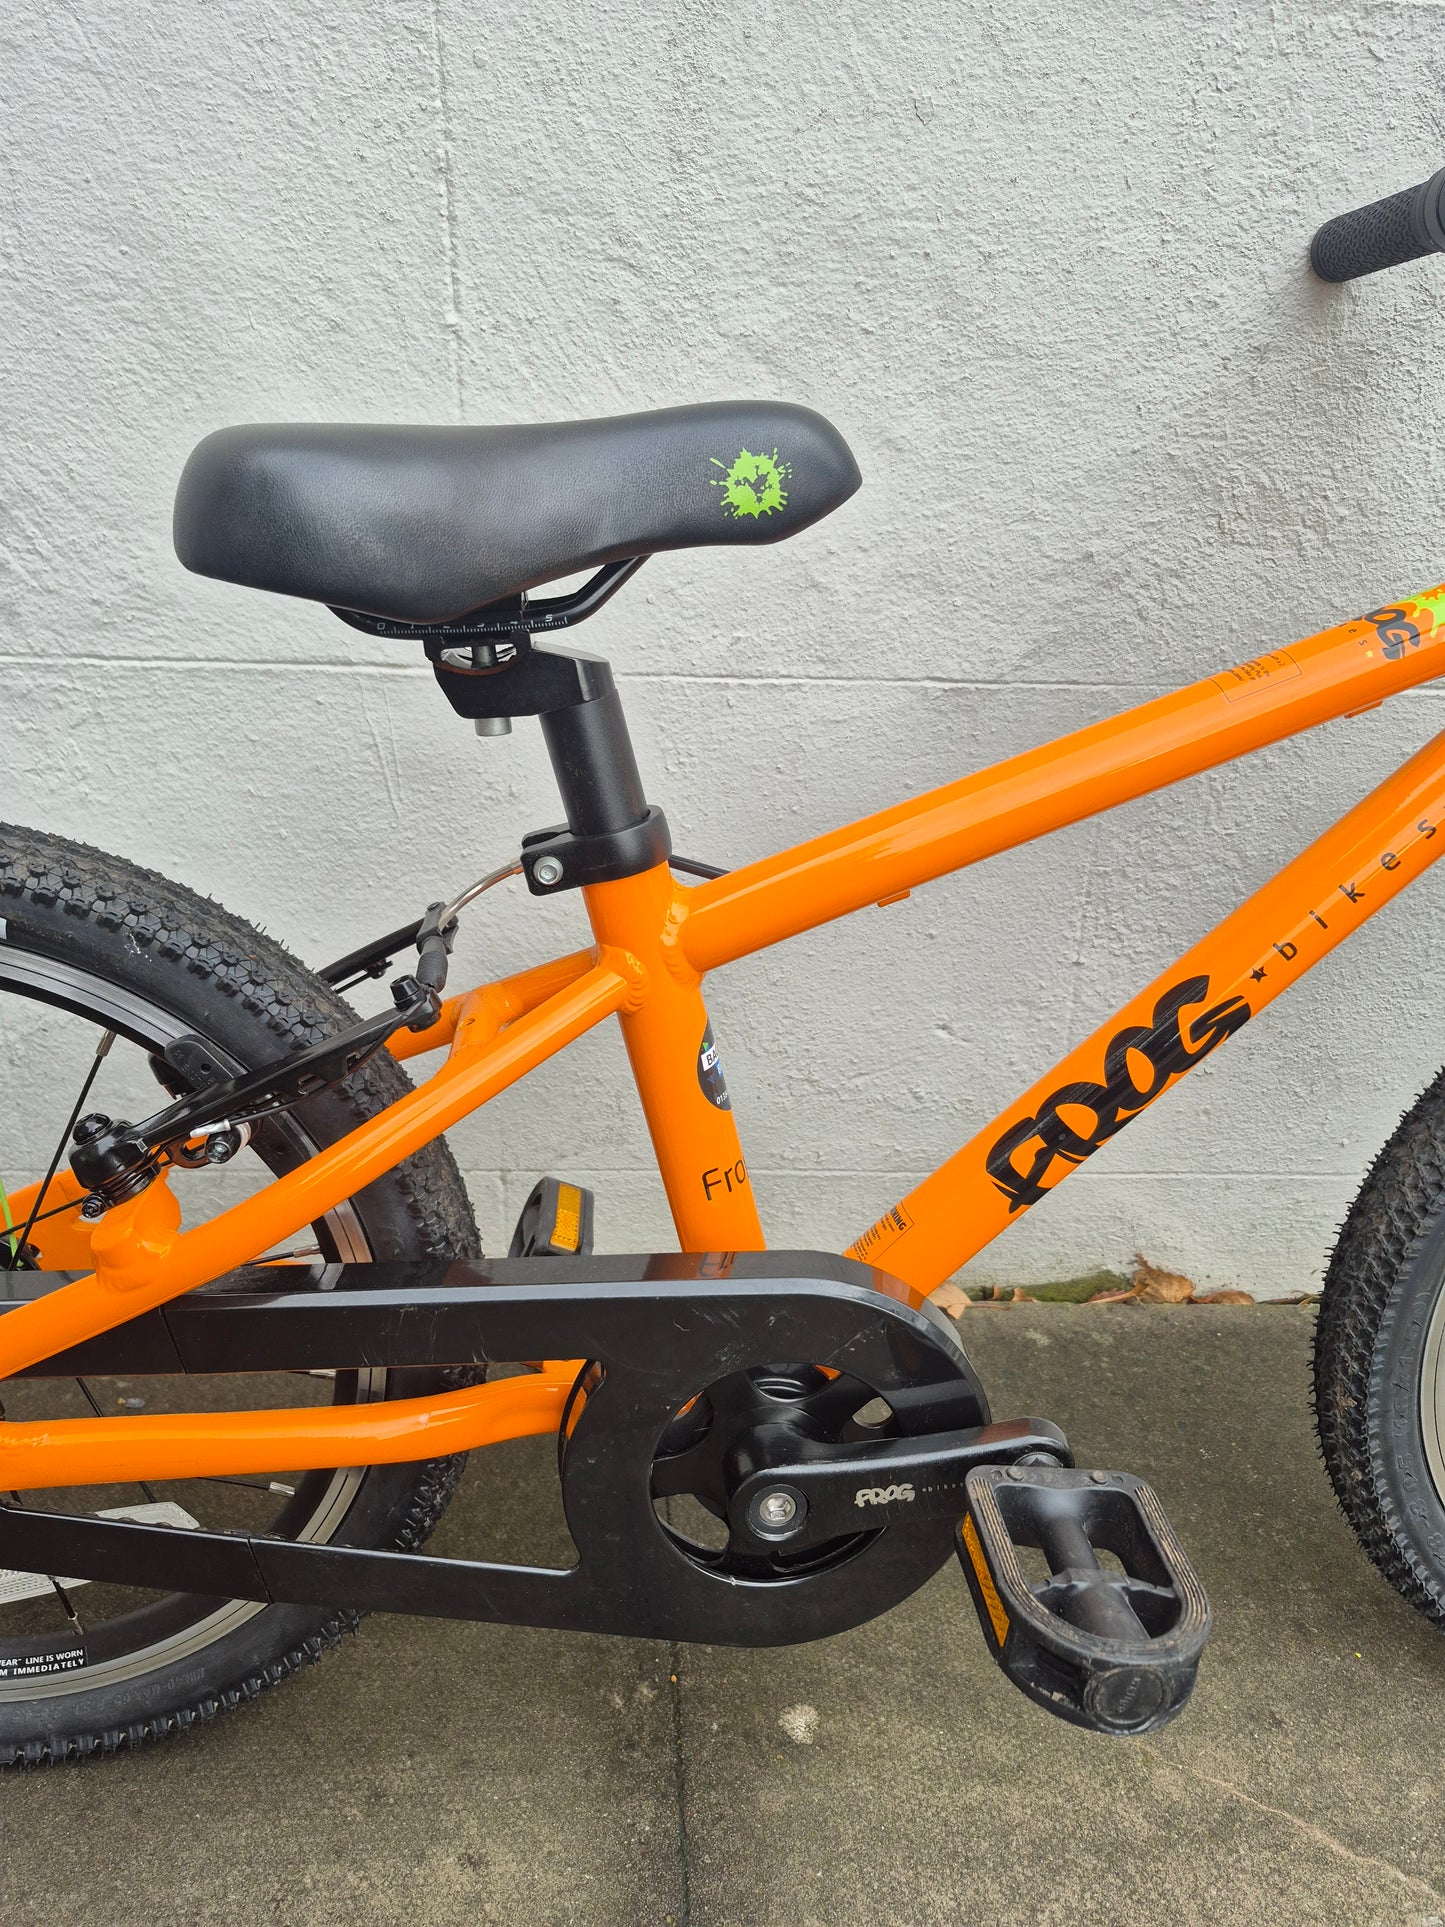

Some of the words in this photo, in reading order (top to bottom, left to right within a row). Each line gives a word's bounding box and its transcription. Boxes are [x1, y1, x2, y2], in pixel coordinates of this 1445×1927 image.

[986, 975, 1251, 1214] FROG
[1272, 818, 1437, 962] bikes
[702, 1158, 749, 1201] Fro
[854, 1483, 916, 1507] FROG
[13, 1658, 84, 1675] IMMEDIATELY
[25, 1655, 44, 1665] LINE
[46, 1654, 54, 1662] IS
[55, 1649, 84, 1661] WORN
